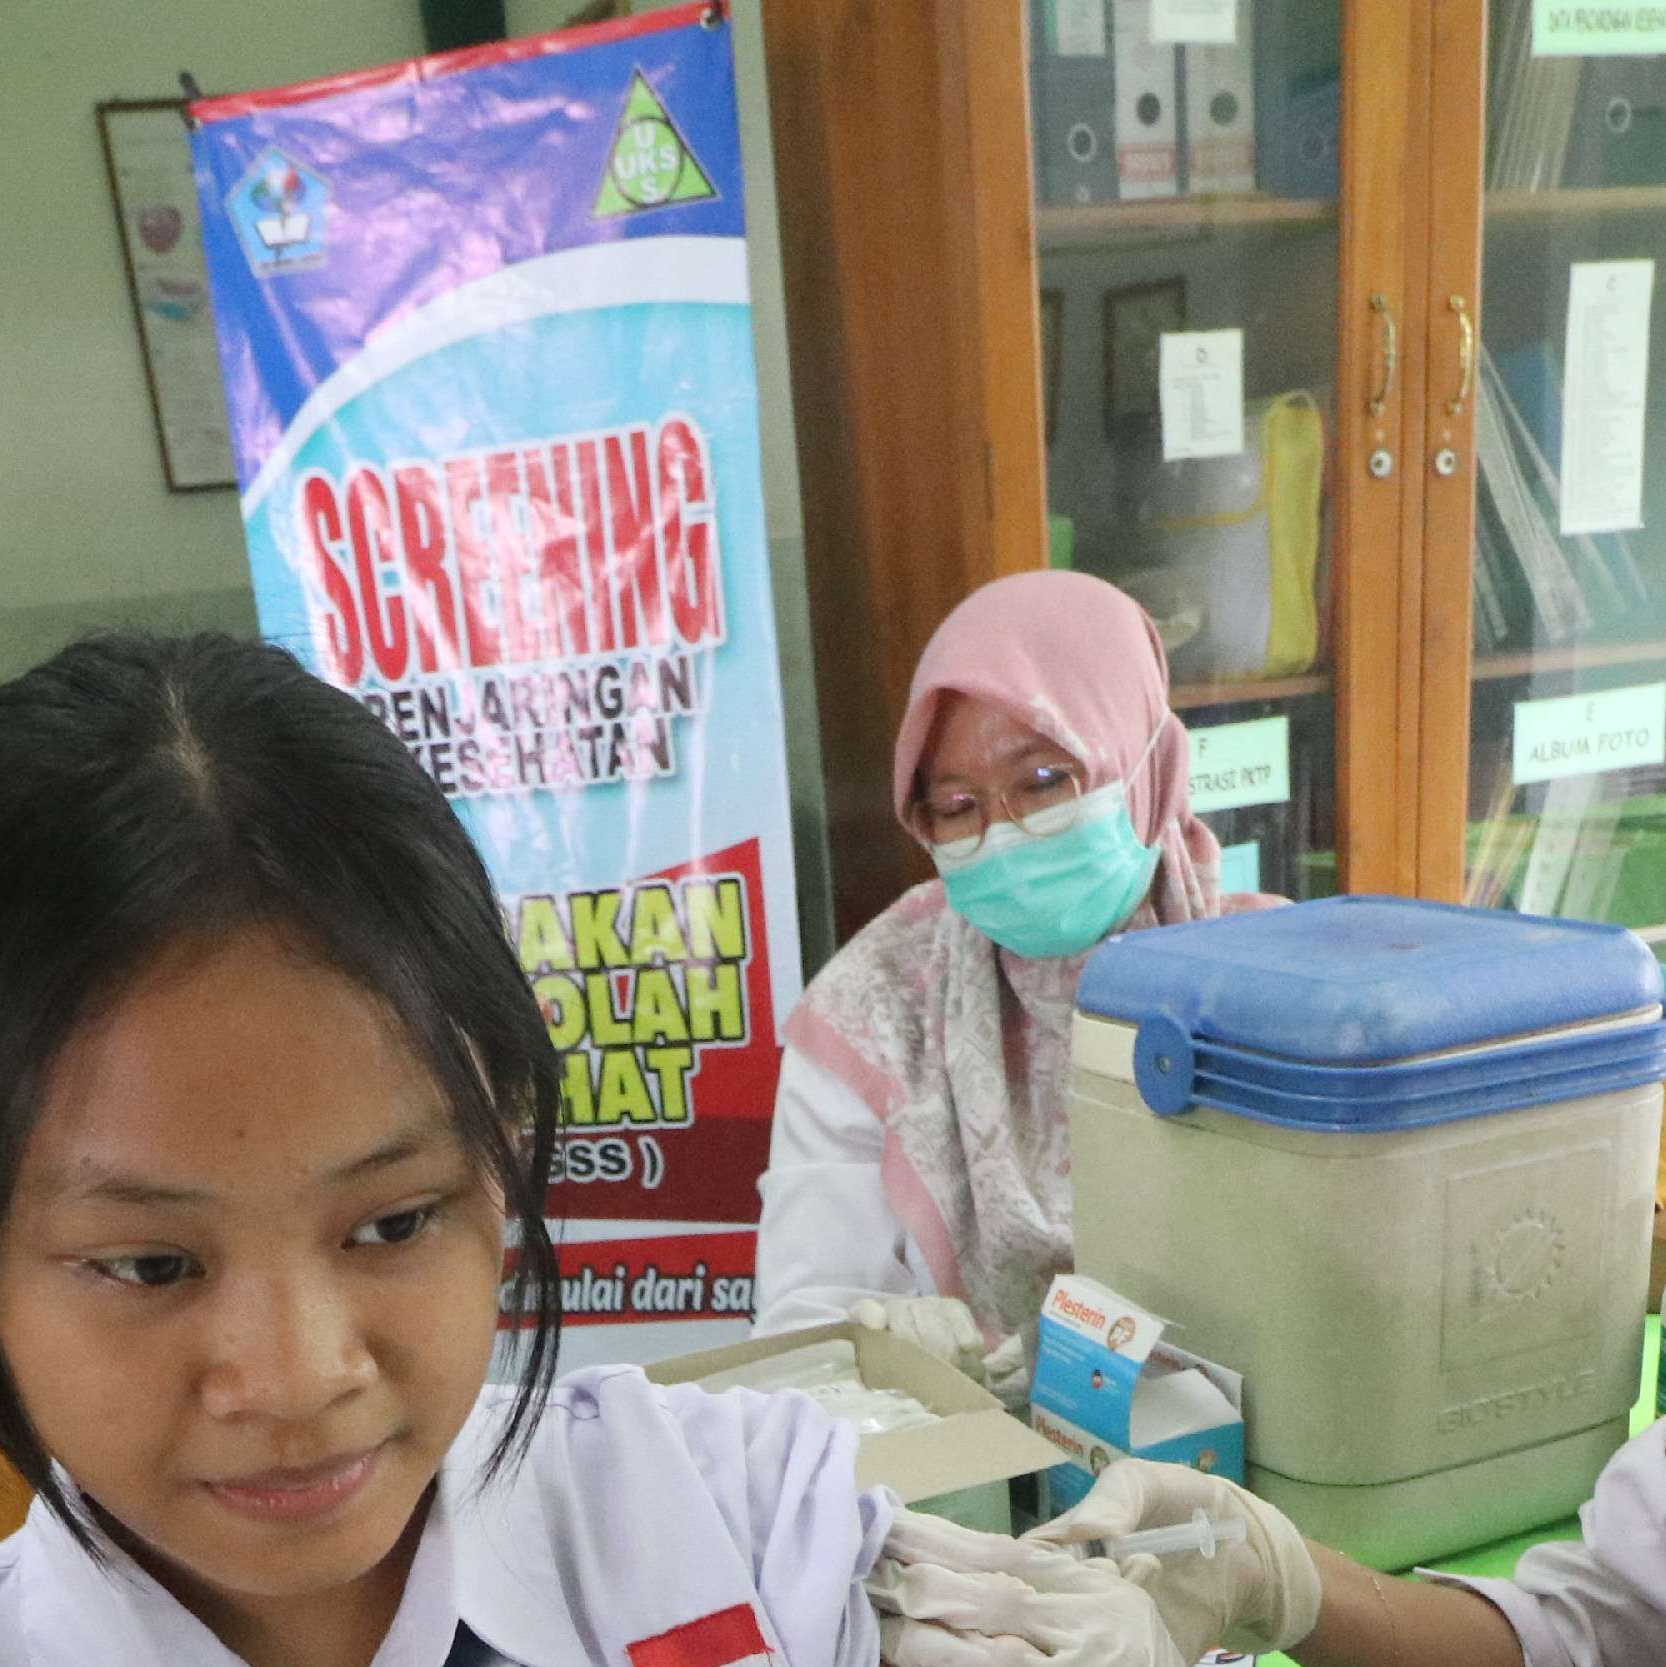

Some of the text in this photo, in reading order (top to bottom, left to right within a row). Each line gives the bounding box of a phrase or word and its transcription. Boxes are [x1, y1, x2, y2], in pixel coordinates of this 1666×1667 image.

[302, 419, 724, 686] SCREENING
[1529, 727, 1650, 763] ALBUM FOTO
[517, 878, 746, 970] AKAN
[539, 963, 745, 1050] OLAH
[559, 1045, 694, 1126] HAT
[631, 1264, 706, 1312] dari
